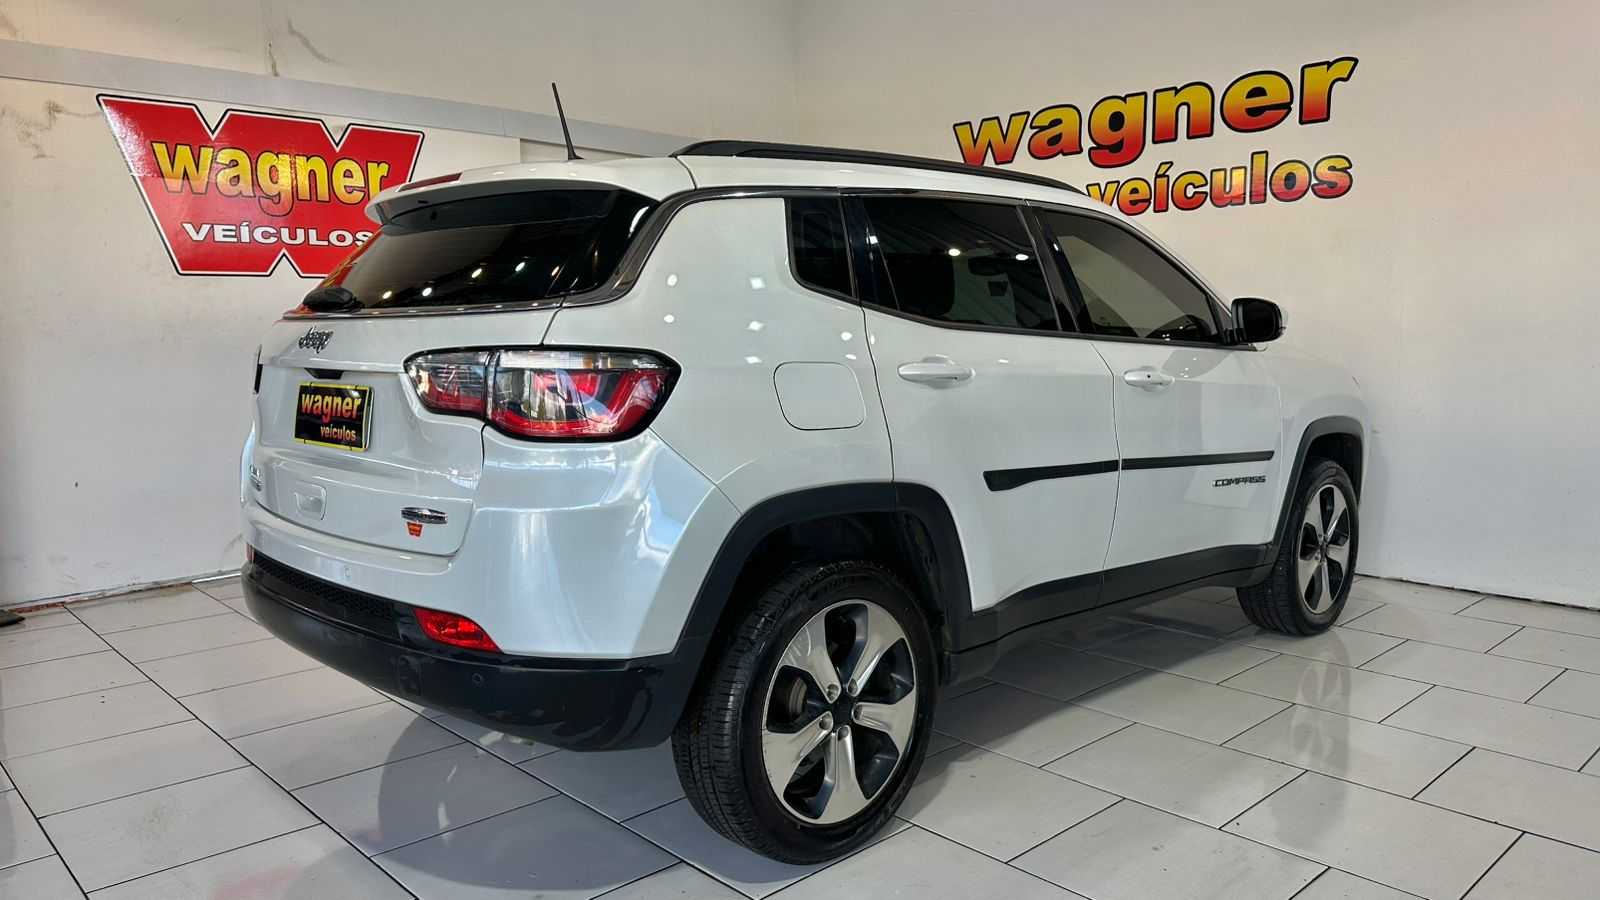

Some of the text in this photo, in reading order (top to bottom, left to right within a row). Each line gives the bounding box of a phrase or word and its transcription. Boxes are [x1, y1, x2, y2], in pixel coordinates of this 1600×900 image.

[953, 56, 1358, 168] wagner
[152, 142, 391, 217] wagner
[1086, 150, 1353, 217] veículos
[181, 220, 375, 247] VEÍCULOS
[301, 393, 362, 423] wagner
[1212, 475, 1267, 487] COMPASS
